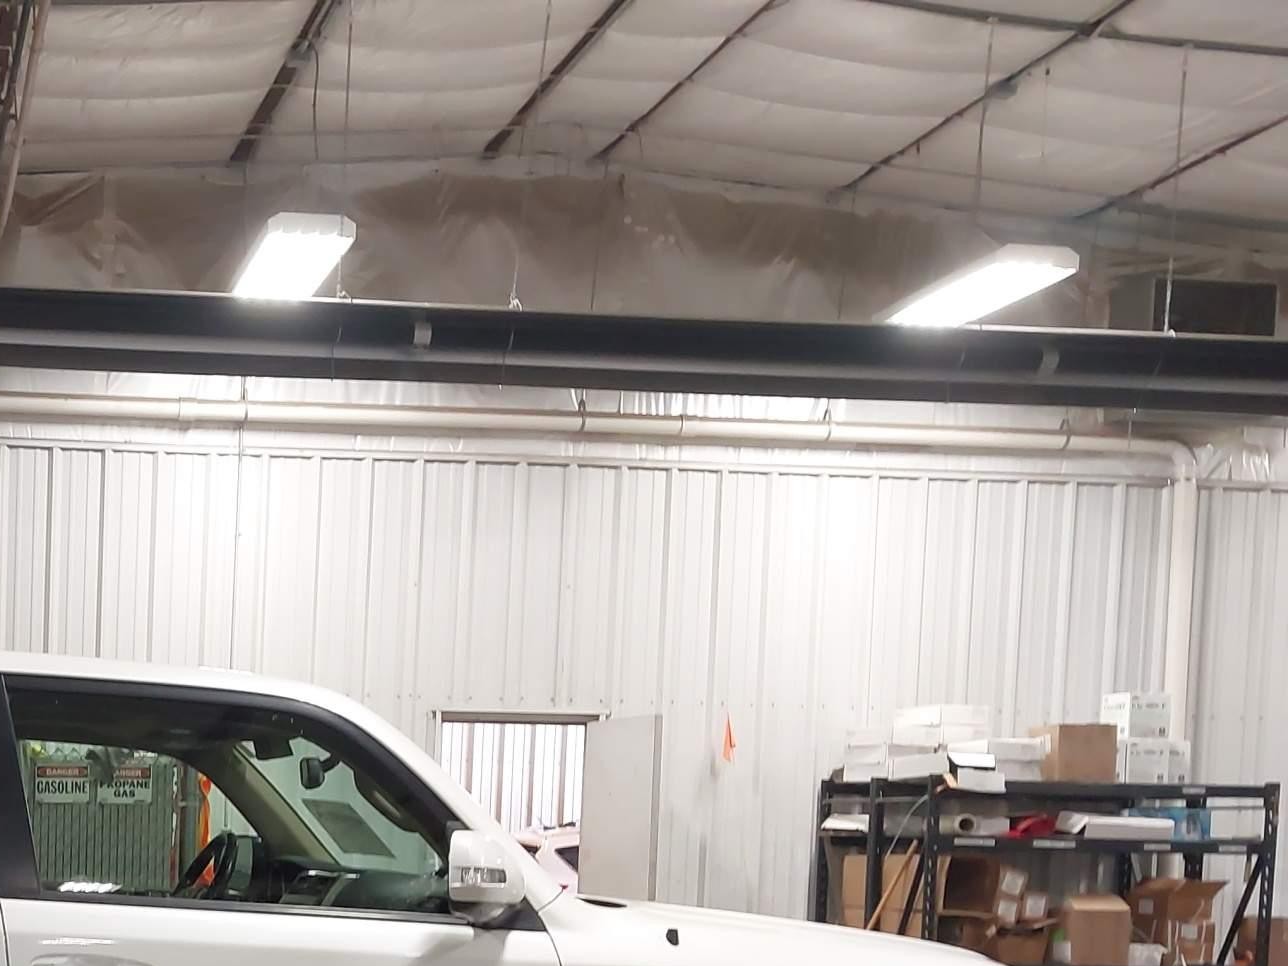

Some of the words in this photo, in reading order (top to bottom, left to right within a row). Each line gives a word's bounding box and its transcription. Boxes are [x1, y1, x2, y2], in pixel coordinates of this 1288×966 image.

[45, 767, 80, 777] DANGER
[113, 768, 142, 778] ANGER
[36, 780, 88, 794] GASOLINE
[113, 789, 136, 798] GAS
